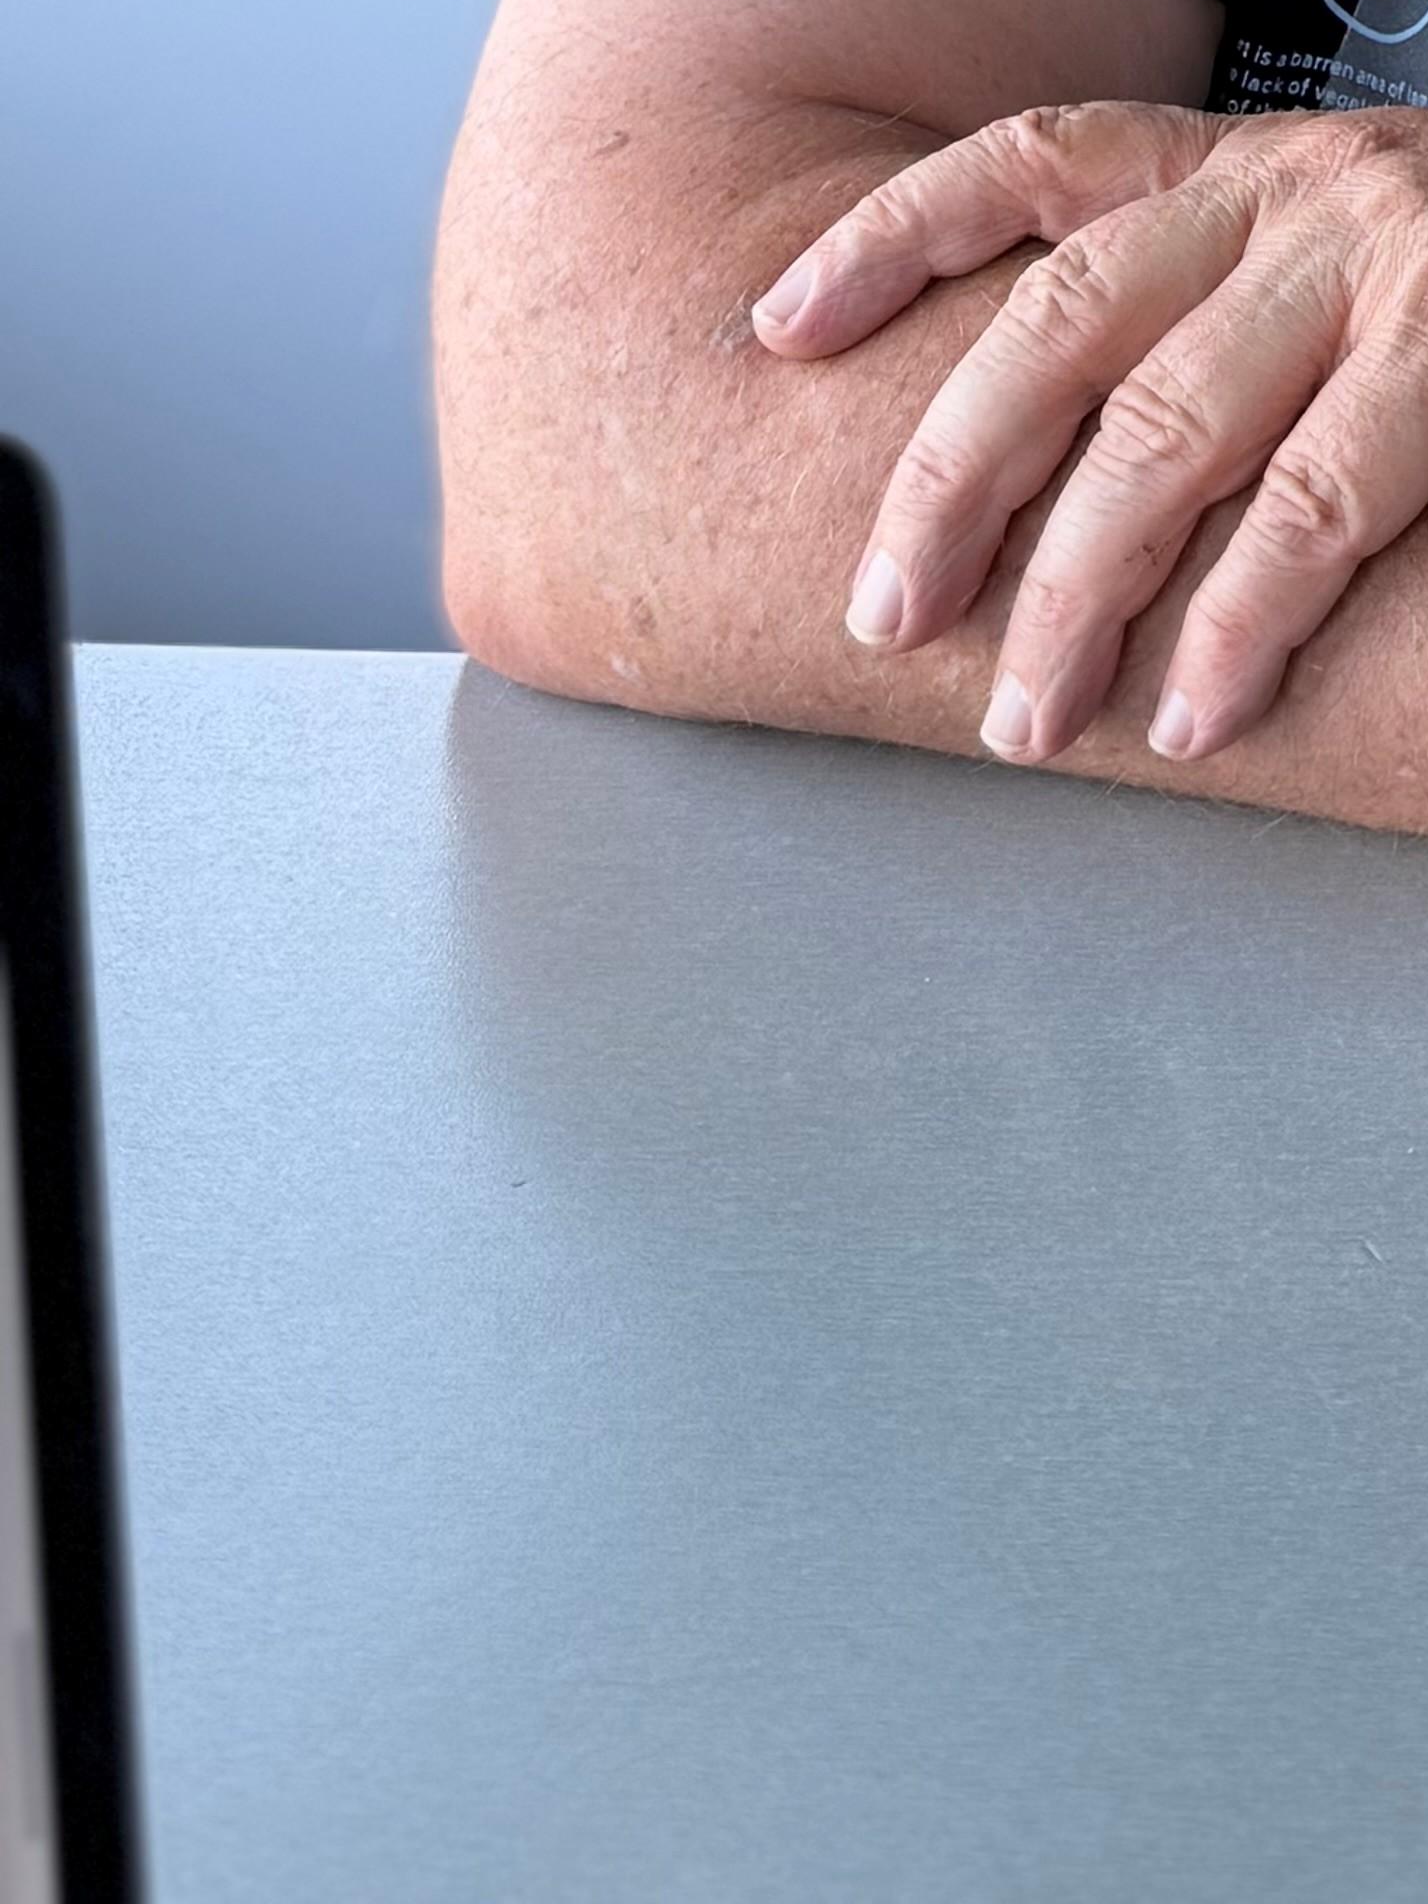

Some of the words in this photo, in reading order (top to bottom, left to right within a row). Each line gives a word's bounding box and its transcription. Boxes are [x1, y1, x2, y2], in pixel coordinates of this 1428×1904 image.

[1253, 43, 1273, 66] is
[1289, 50, 1354, 81] barren
[1239, 67, 1285, 95] lack
[1286, 76, 1313, 97] of
